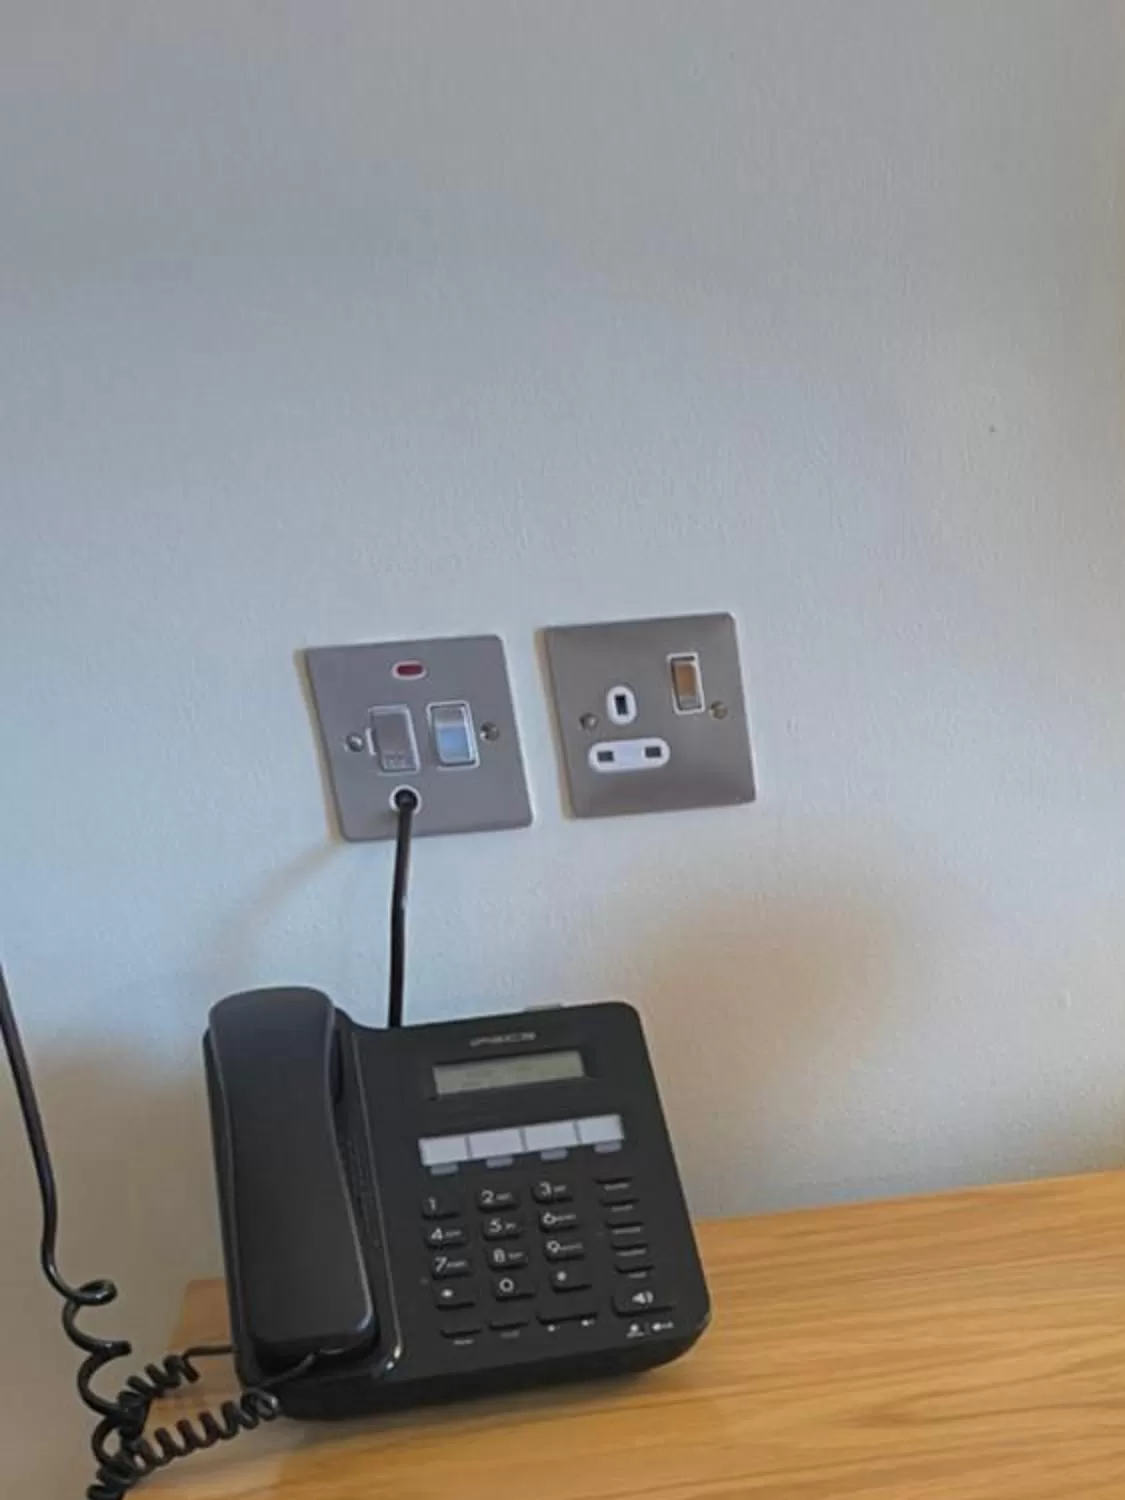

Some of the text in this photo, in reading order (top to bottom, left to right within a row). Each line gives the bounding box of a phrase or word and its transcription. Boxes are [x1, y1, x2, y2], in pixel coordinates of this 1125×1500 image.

[481, 1189, 495, 1204] 2
[539, 1181, 551, 1197] 3
[427, 1195, 438, 1212] 1
[489, 1218, 503, 1233] 5
[542, 1211, 556, 1226] 6
[430, 1227, 443, 1241] 4
[546, 1239, 561, 1254] 9
[434, 1256, 448, 1272] 7
[499, 1277, 515, 1293] 0
